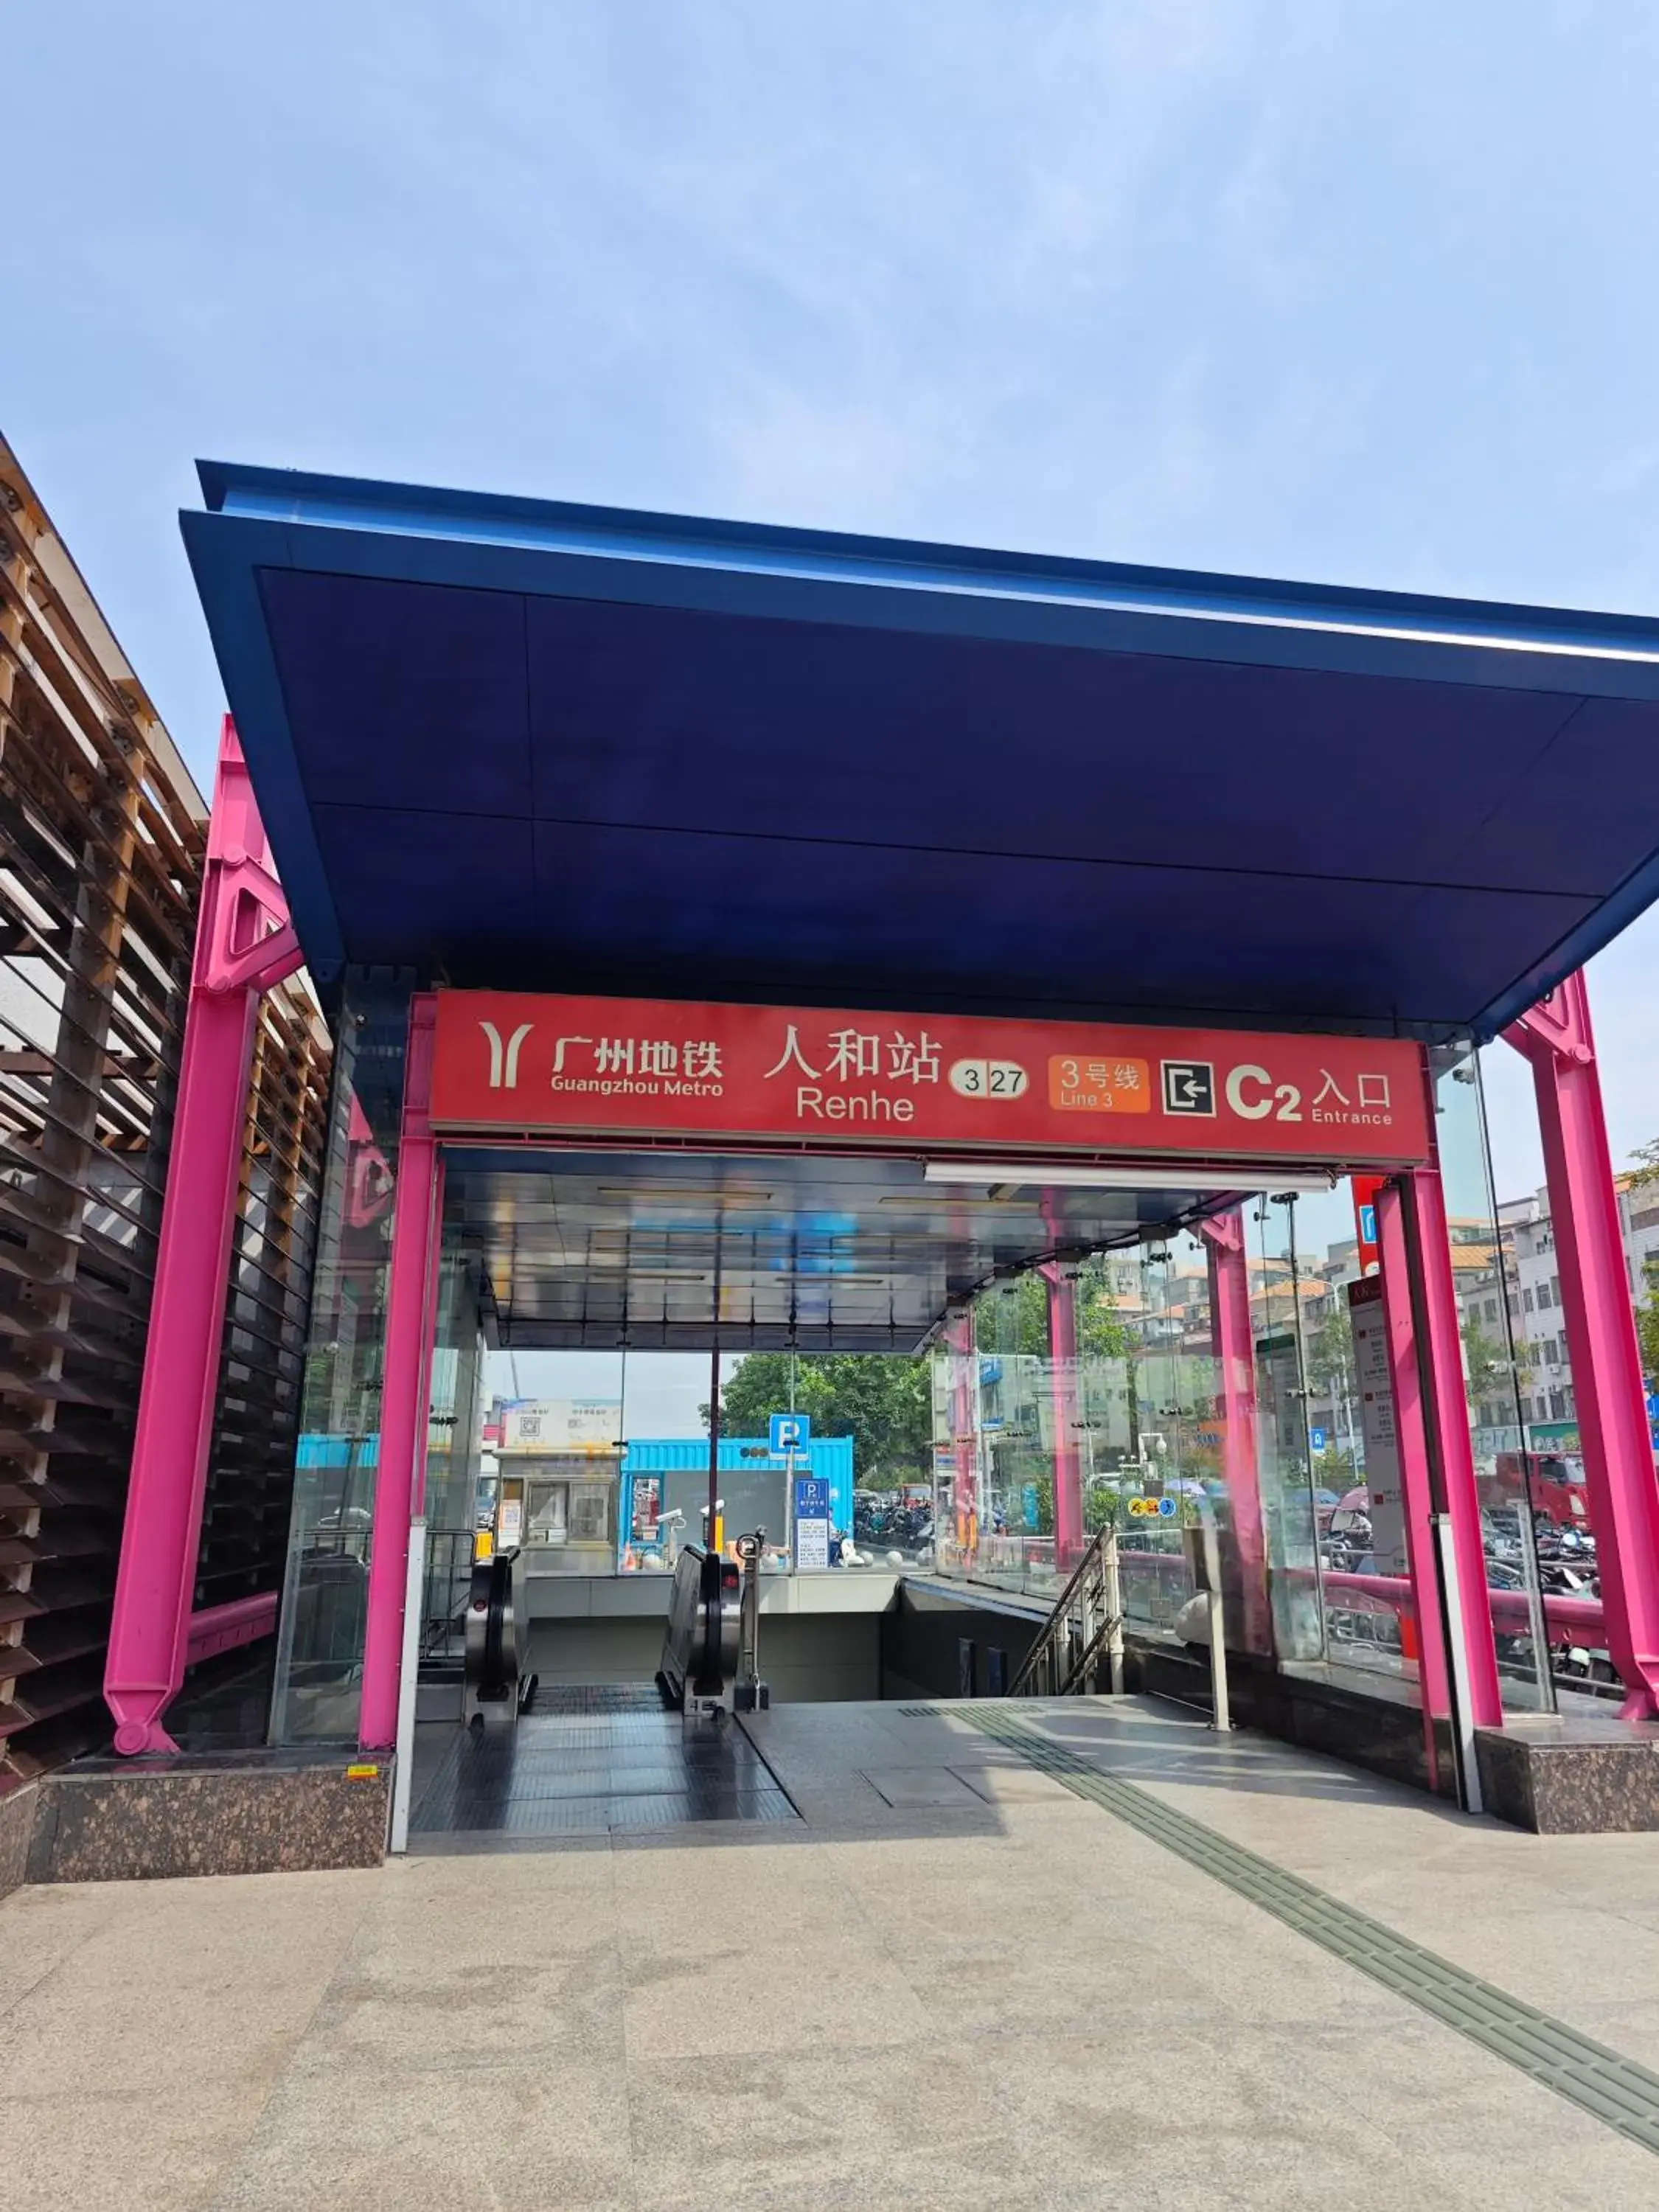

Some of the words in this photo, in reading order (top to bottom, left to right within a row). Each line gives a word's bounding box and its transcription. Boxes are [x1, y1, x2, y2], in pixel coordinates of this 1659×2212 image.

[552, 1035, 723, 1078] 广州地铁
[764, 1024, 943, 1084] 人和站
[551, 1074, 658, 1095] Guangzhou
[664, 1080, 723, 1096] Metro
[1060, 1060, 1140, 1091] 3号线
[1312, 1068, 1391, 1108] 入口
[797, 1087, 915, 1121] Renhe
[1060, 1090, 1098, 1107] Line
[1102, 1093, 1113, 1108] 3
[1225, 1064, 1303, 1121] C2
[1312, 1109, 1392, 1125] Entrance
[778, 1420, 801, 1449] P
